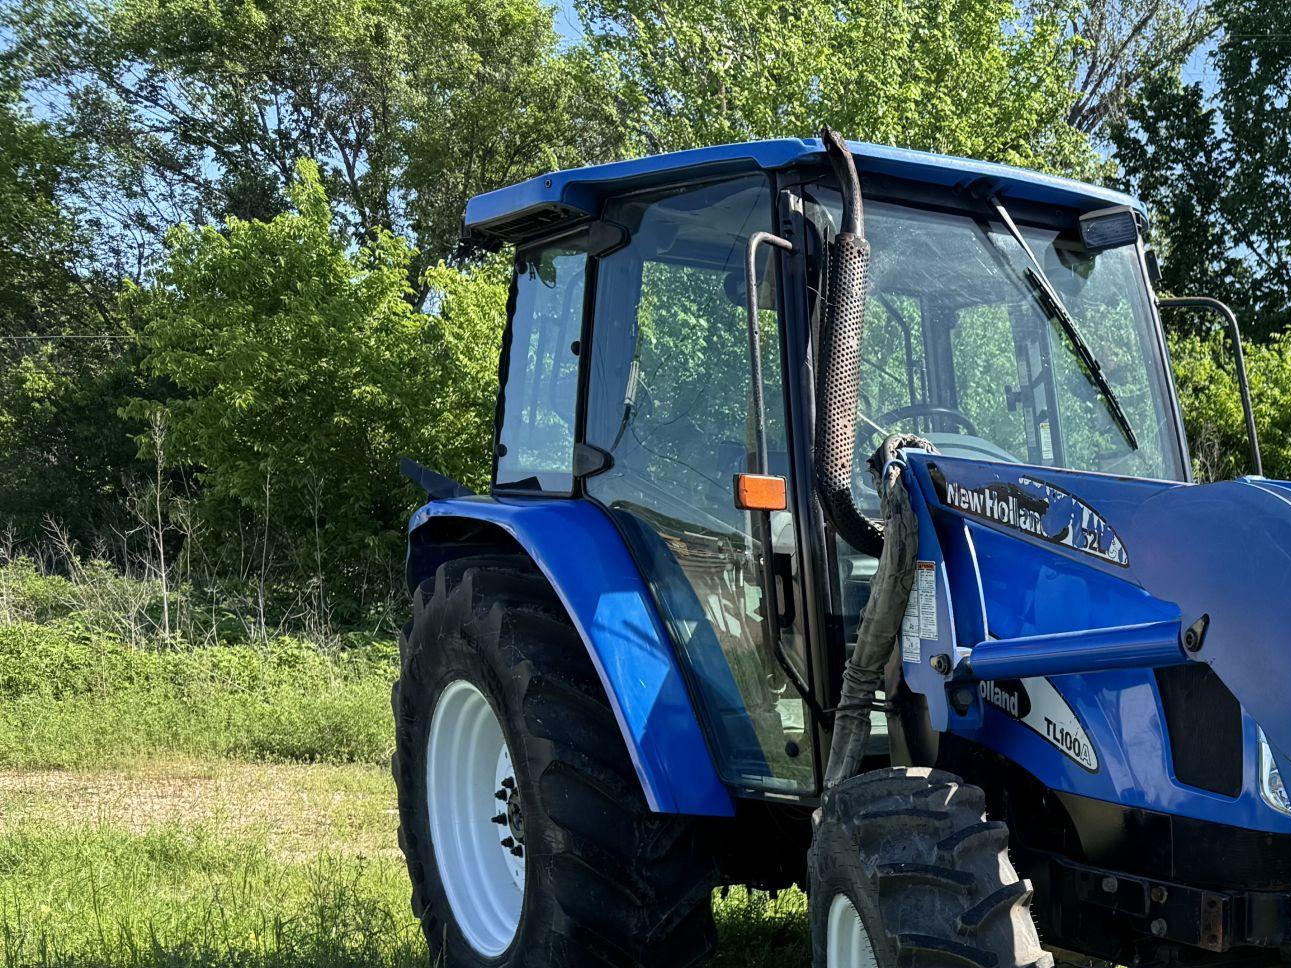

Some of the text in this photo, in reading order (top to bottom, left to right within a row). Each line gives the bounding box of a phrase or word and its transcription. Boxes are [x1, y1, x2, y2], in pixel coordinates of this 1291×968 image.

[945, 481, 983, 513] New
[979, 679, 1019, 718] olland
[1044, 716, 1092, 766] TL100A
